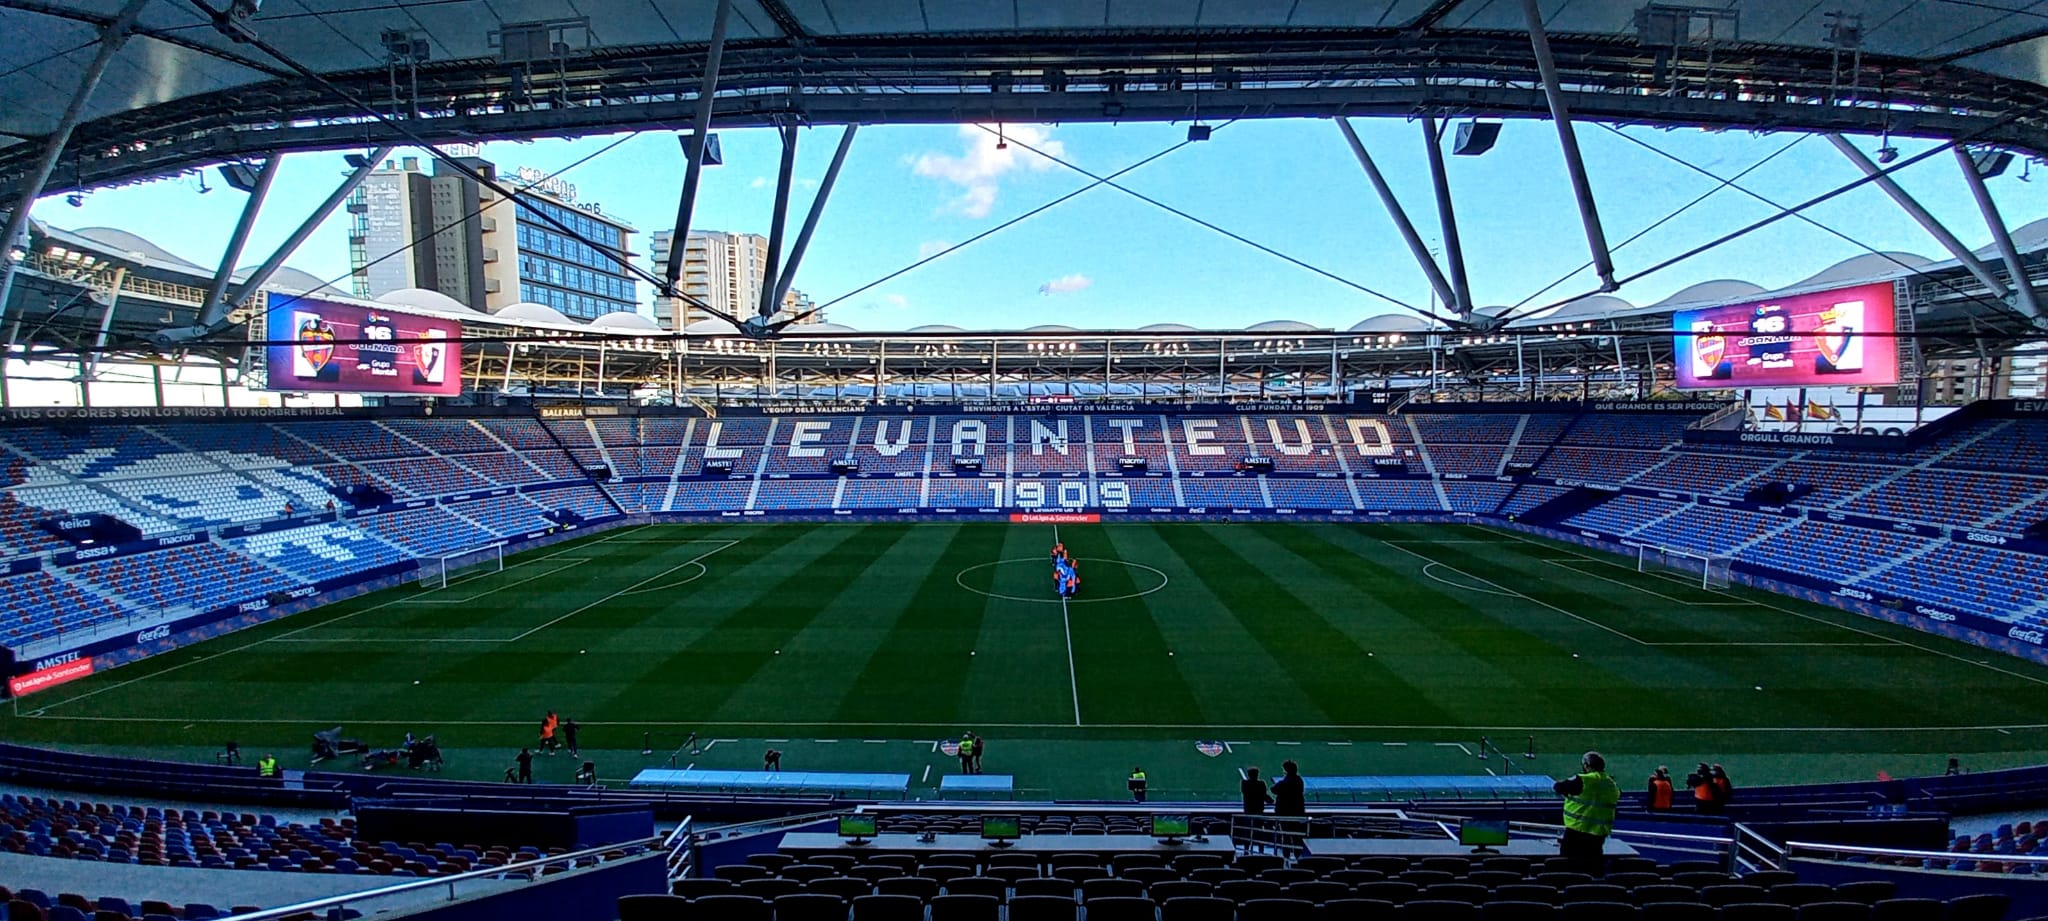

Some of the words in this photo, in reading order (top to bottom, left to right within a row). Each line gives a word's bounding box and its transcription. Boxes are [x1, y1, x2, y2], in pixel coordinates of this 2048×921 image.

[1752, 316, 1785, 333] 16
[364, 326, 392, 340] 16
[10, 408, 41, 418] TUS
[121, 408, 150, 417] SON
[155, 408, 180, 417] LOS
[220, 408, 229, 416] Y
[233, 408, 248, 416] TU
[251, 408, 298, 416] NOMBRE
[314, 408, 345, 416] IDEAL
[703, 419, 1226, 458] LEVANTE
[1266, 419, 1413, 457] U.D.
[1740, 433, 1780, 442] ORGULL
[1782, 434, 1834, 445] GRANOTA
[988, 480, 1131, 508] 1909
[58, 518, 91, 530] teika
[1055, 514, 1088, 522] Santander
[159, 533, 196, 546] macron
[36, 651, 81, 672] AMSTEL
[53, 663, 91, 680] Santander
